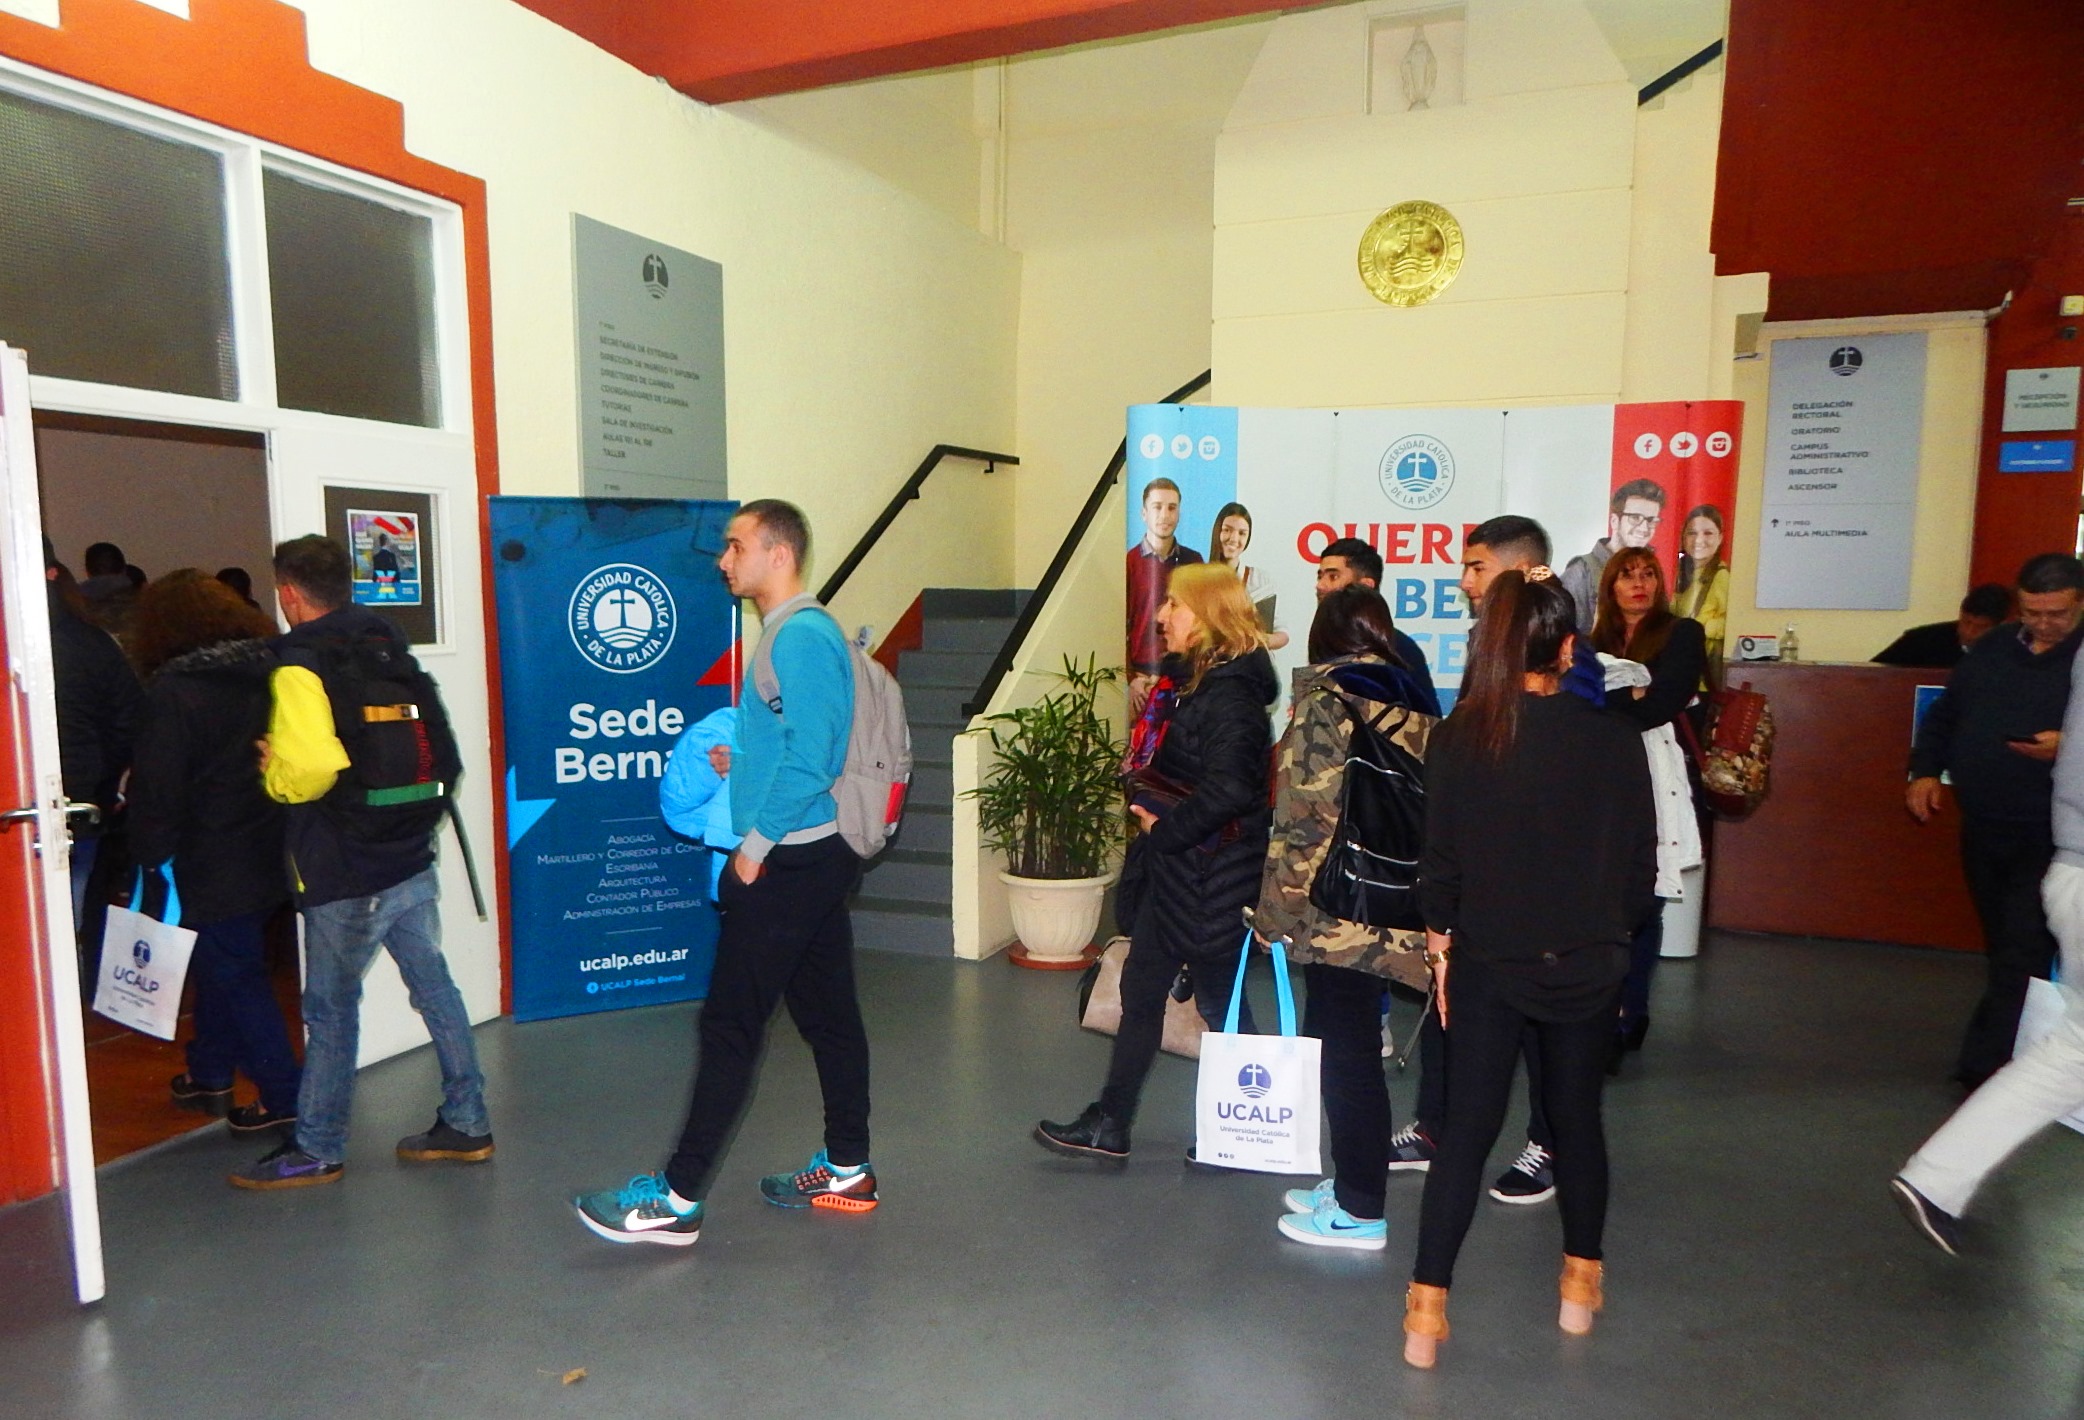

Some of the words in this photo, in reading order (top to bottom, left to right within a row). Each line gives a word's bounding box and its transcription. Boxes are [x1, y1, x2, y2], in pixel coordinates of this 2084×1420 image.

[1792, 400, 1853, 410] DELEGACIÓN
[1792, 411, 1841, 419] RECTORAL
[1791, 427, 1841, 435] ORATORIO
[1385, 440, 1425, 480] UNIVERSIDAD
[1427, 443, 1450, 479] CATOLICA
[1790, 451, 1869, 460] ADMINISTRATIVO
[1788, 467, 1843, 475] BIBLIOTECA
[1391, 487, 1402, 498] DE
[1403, 495, 1414, 504] LA
[1418, 486, 1443, 504] PLATA
[1811, 529, 1868, 537] MULTIMEDIA
[577, 572, 632, 630] UNIVERSIDAD
[634, 576, 669, 628] CATOLICA
[588, 639, 606, 658] DE
[606, 650, 622, 666] LA
[626, 638, 662, 664] PLATA
[569, 699, 685, 740] Sede
[537, 852, 596, 865] MARTILLERO
[607, 848, 658, 860] CORREDOR
[661, 846, 672, 854] DE
[598, 875, 667, 888] ARQUITECTURA
[586, 892, 638, 904] CONTADOR
[642, 904, 654, 912] DE
[656, 899, 702, 912] EMPRESAS
[580, 948, 689, 972] ucalp.edu.ar
[113, 965, 160, 994] UCALP
[600, 980, 632, 991] UCALP
[634, 978, 656, 987] Sede
[658, 974, 686, 984] Bernal
[1218, 1102, 1293, 1124] UCALP
[1220, 1125, 1260, 1136] Universidad
[1262, 1130, 1290, 1138] Católica
